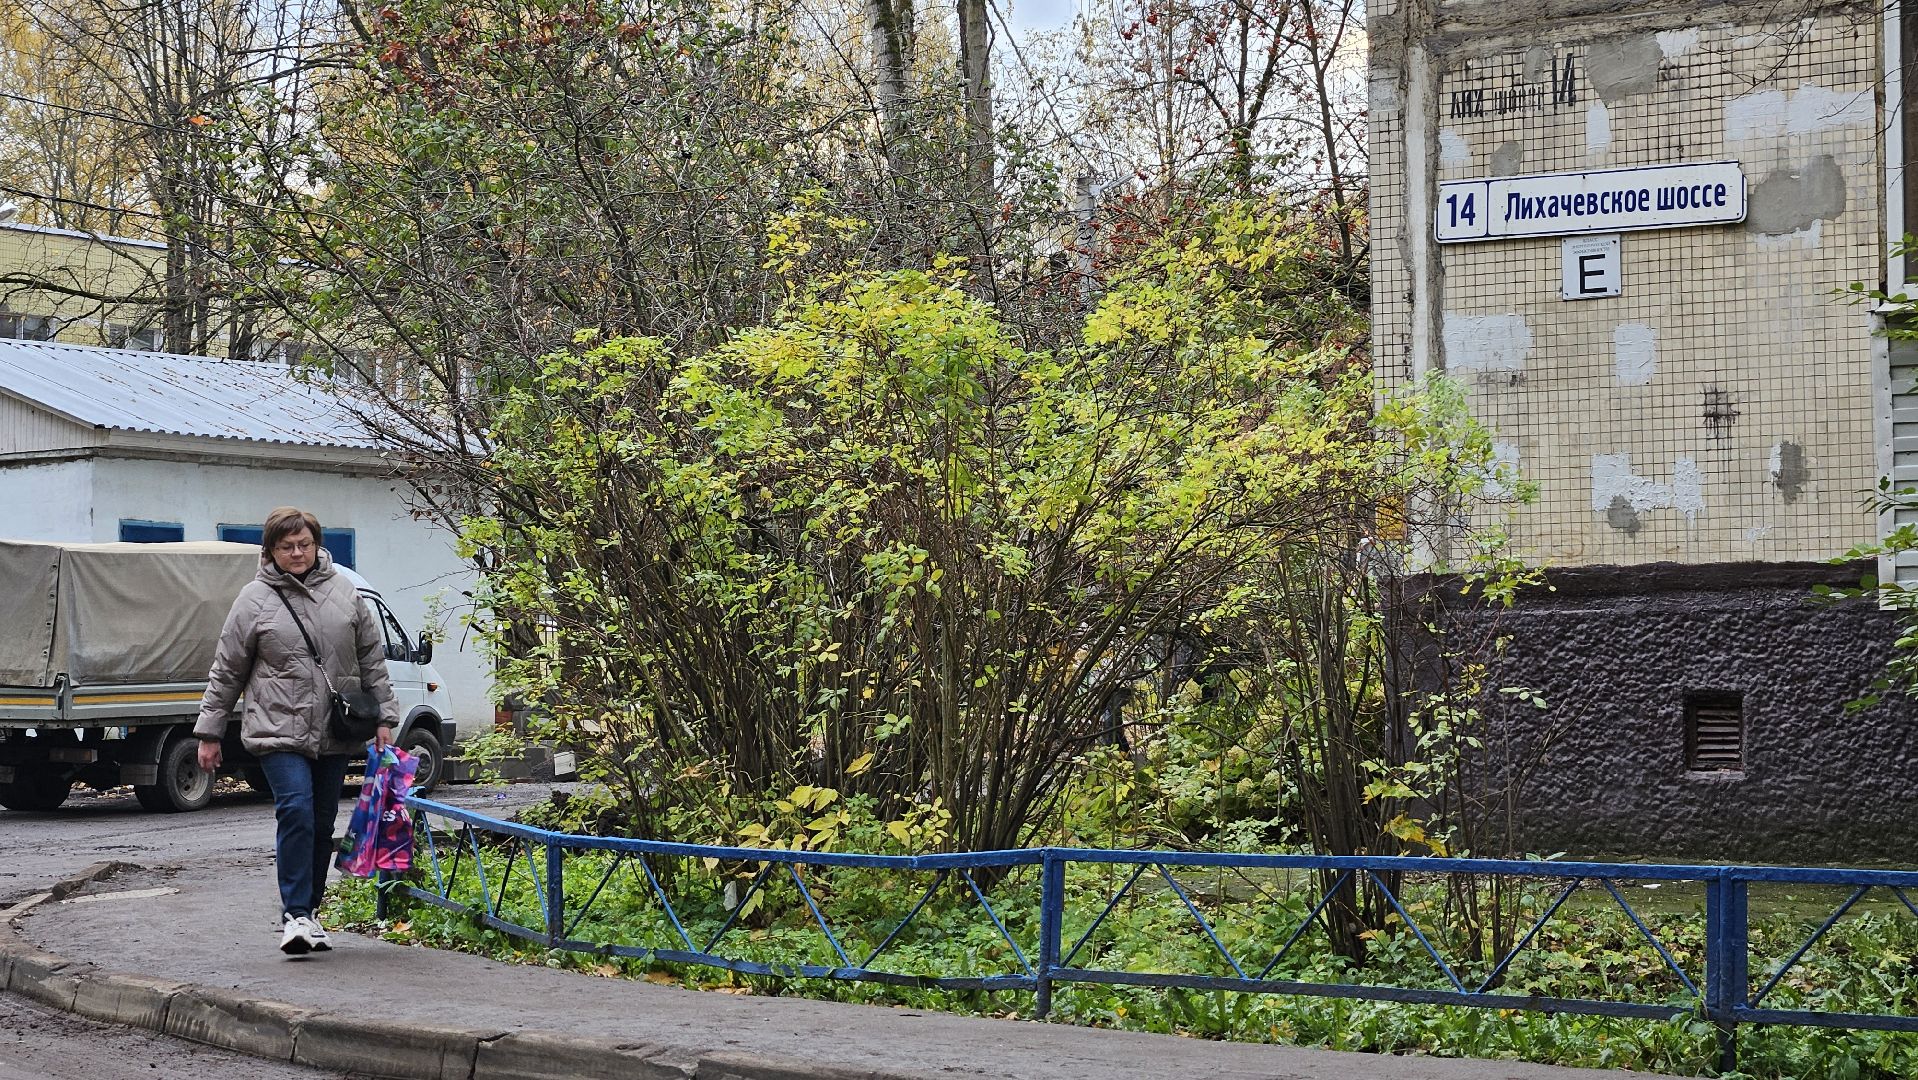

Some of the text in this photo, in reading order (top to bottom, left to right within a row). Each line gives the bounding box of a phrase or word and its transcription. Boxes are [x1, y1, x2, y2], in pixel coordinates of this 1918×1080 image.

[1446, 183, 1727, 227] 14 Лихачевское шоссе
